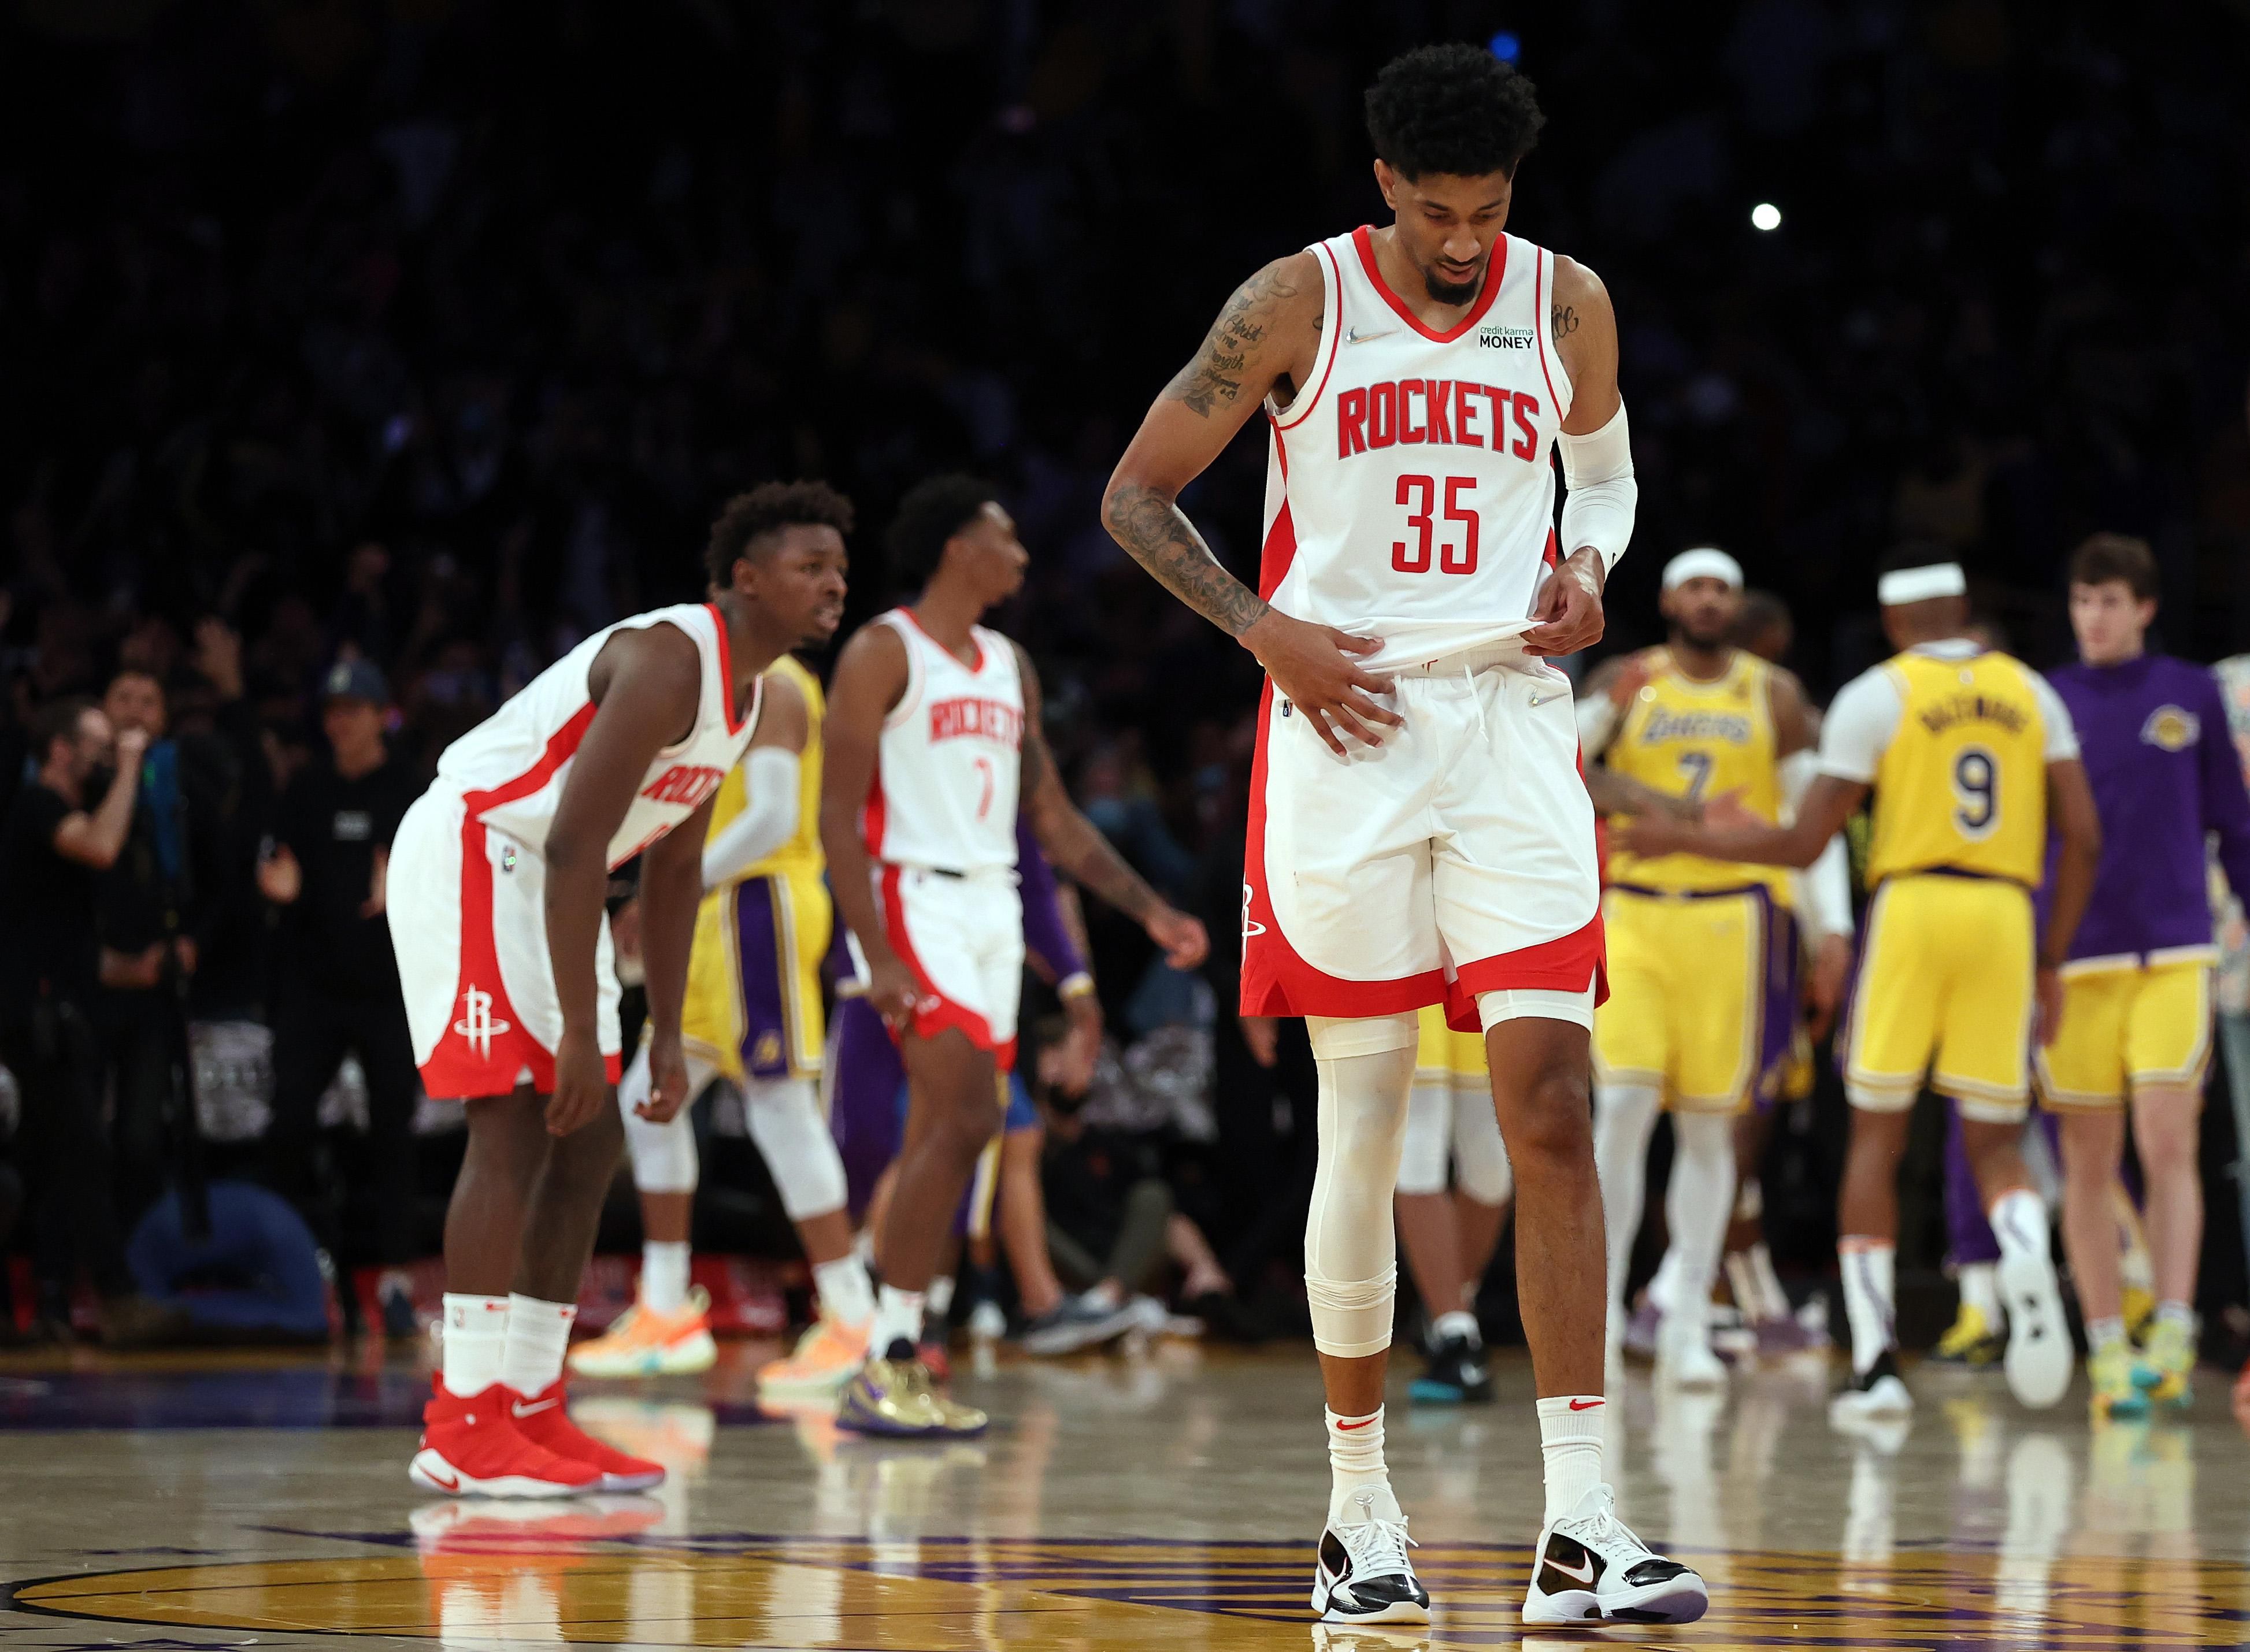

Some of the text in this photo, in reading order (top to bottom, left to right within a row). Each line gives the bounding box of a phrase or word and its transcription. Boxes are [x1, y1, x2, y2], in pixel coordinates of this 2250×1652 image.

[1480, 325, 1533, 336] credit karma
[1480, 335, 1533, 349] MONEY
[1337, 378, 1540, 463] ROCKETS
[1391, 474, 1480, 575] 35
[973, 757, 995, 822] 7
[1677, 751, 1712, 801] 7
[1953, 749, 1997, 835] 9
